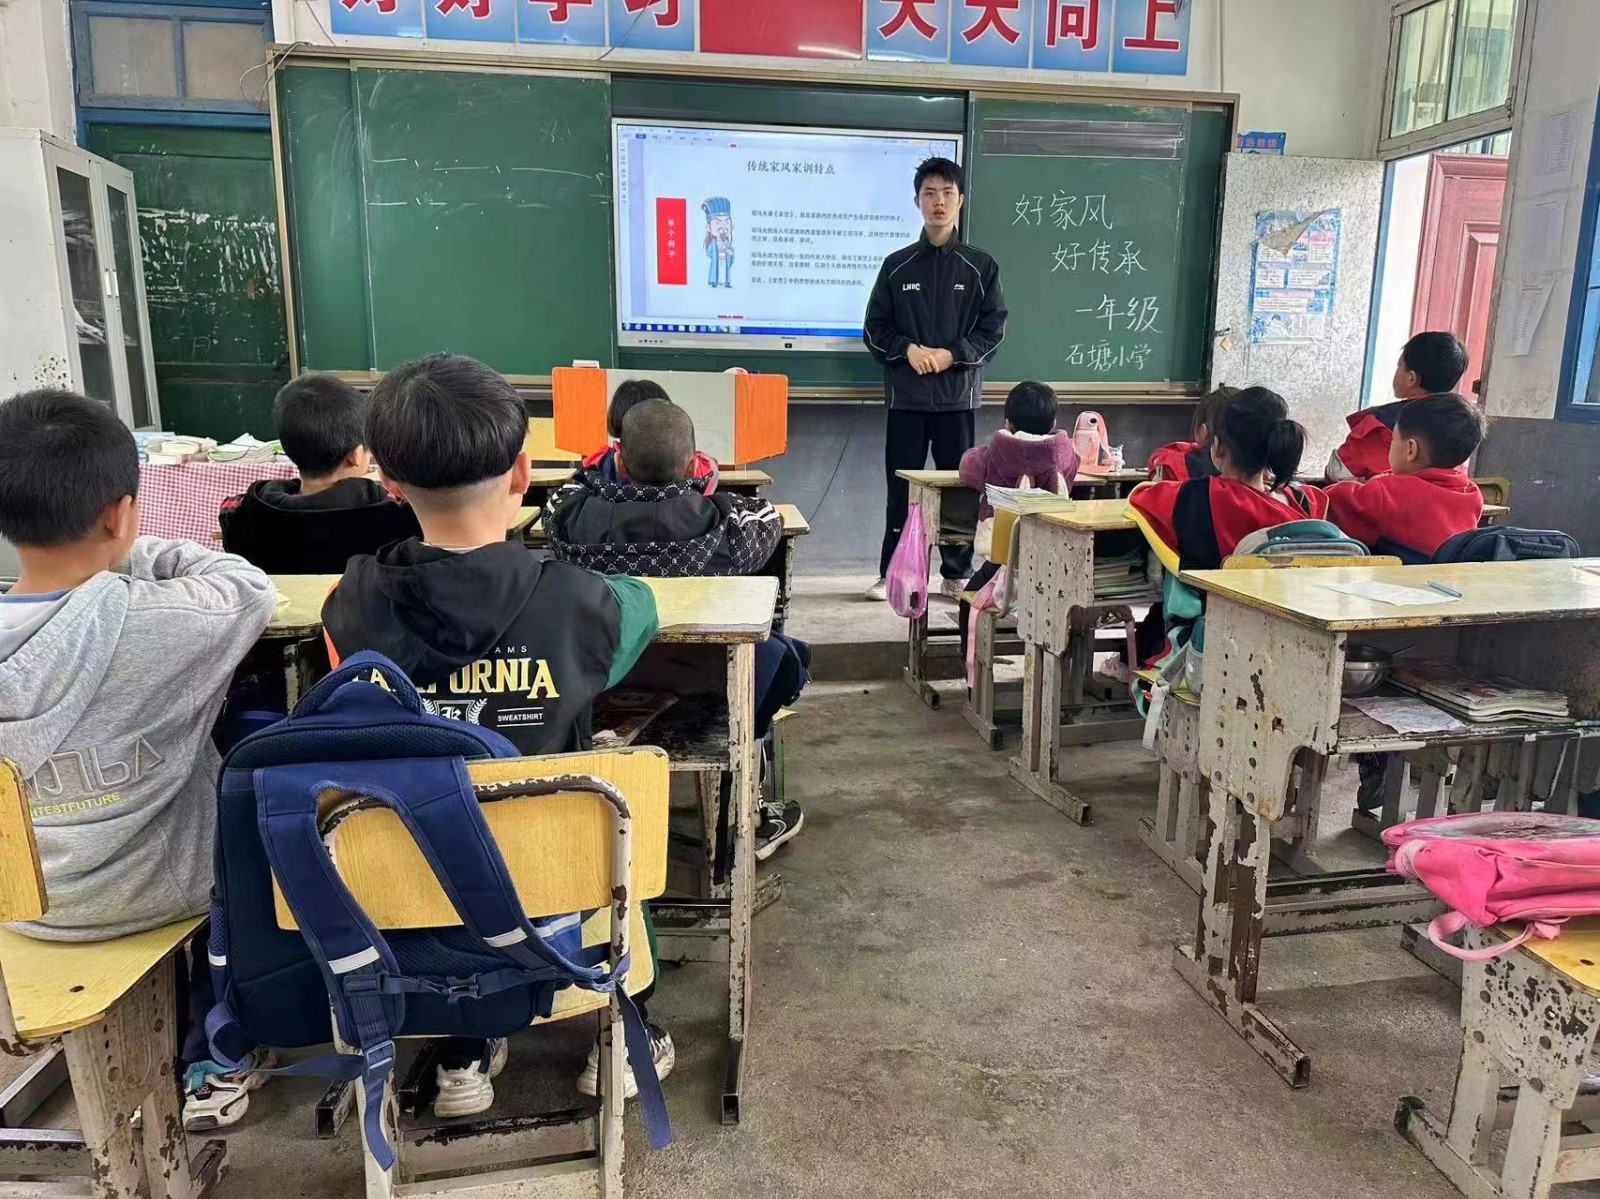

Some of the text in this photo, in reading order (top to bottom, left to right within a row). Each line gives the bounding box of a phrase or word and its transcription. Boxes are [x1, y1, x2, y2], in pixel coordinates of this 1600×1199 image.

[747, 159, 835, 175] 传统家风家训特点
[1012, 189, 1114, 230] 好家风
[1051, 238, 1148, 275] 好传承
[1075, 293, 1162, 333] 一年级
[1065, 339, 1152, 372] 石塘小学
[486, 645, 527, 654] AMS
[497, 712, 543, 722] SWEATSHIRT
